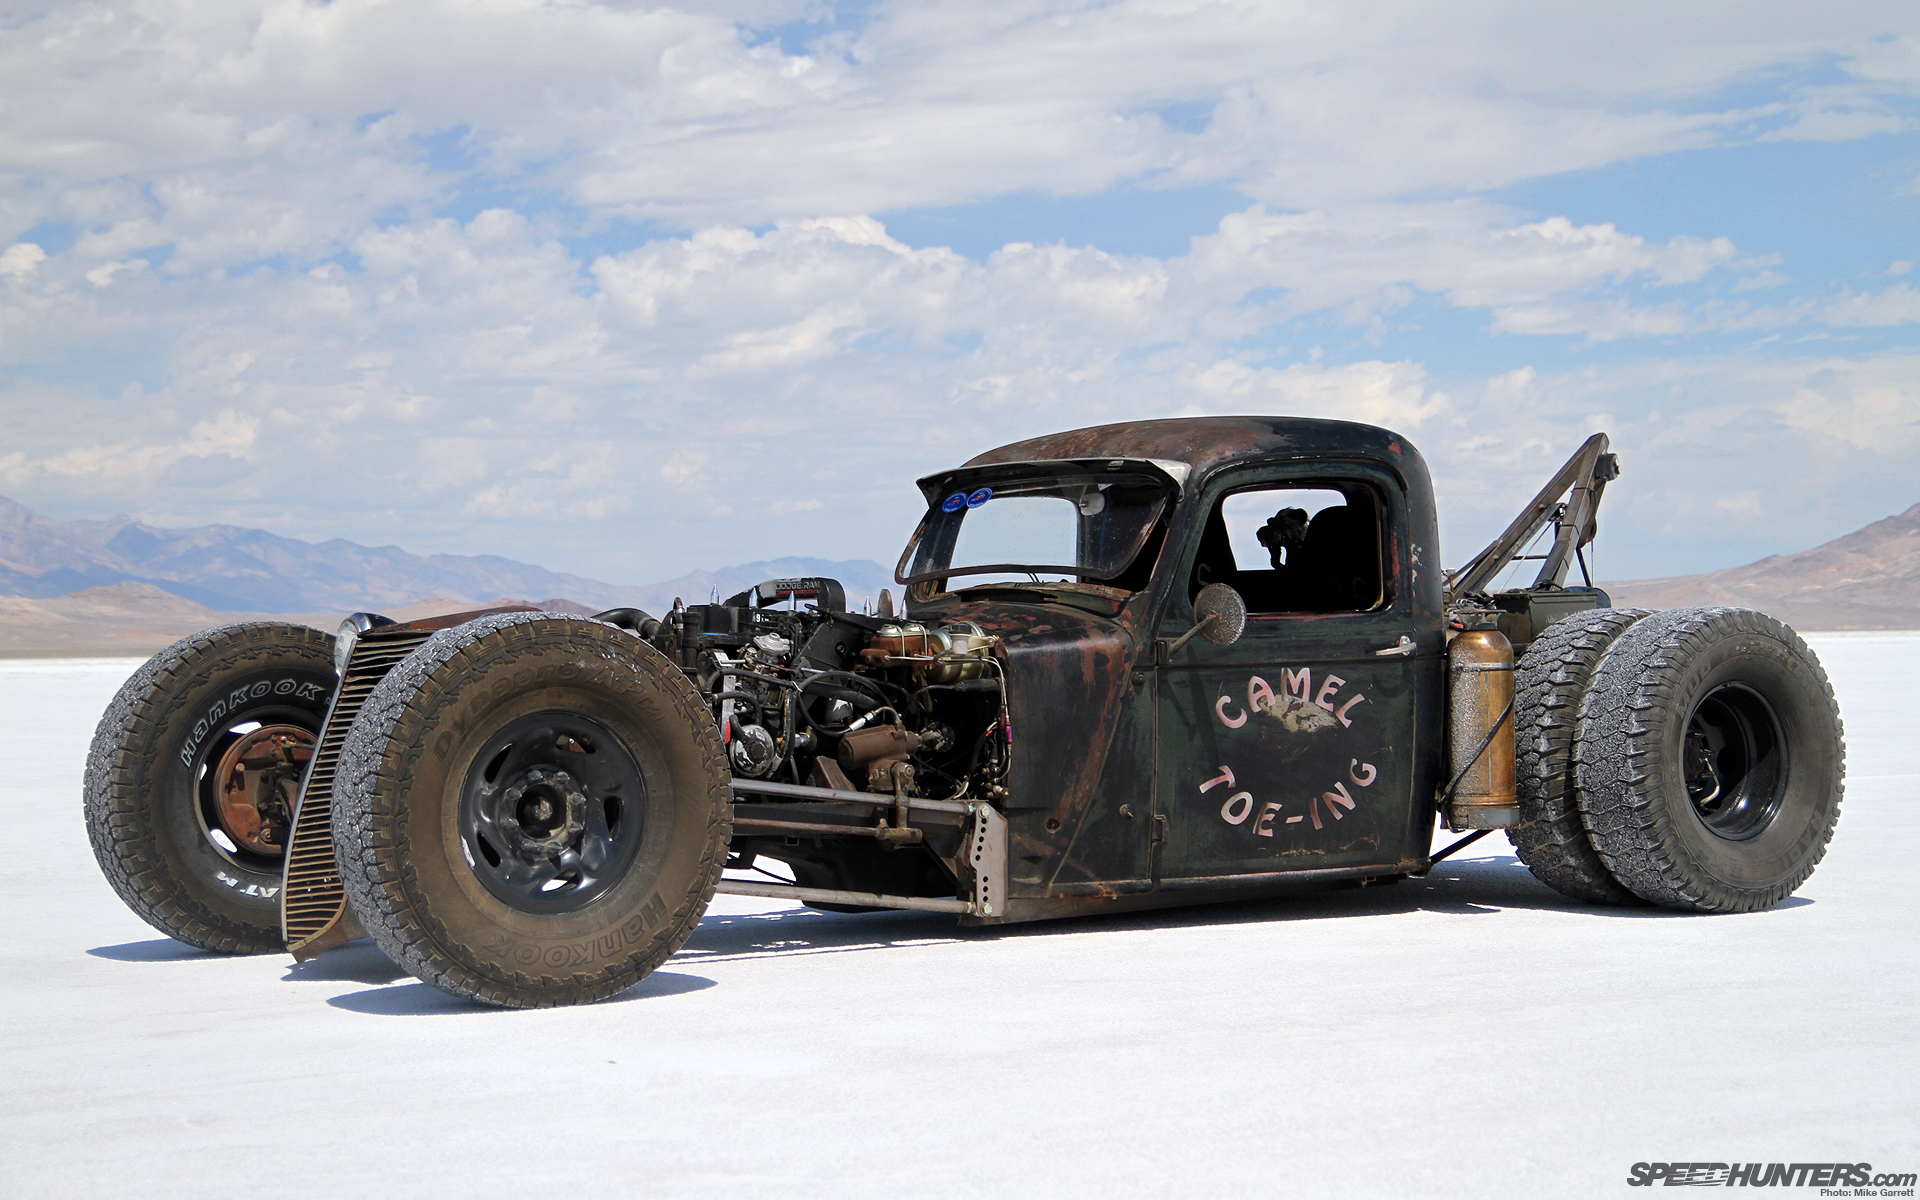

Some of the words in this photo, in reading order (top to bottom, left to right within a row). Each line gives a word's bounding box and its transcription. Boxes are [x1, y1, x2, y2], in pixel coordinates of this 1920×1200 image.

[775, 582, 803, 590] DODGE
[803, 580, 821, 589] RAM
[1215, 667, 1365, 728] CAMEL
[1199, 758, 1377, 837] TOE-ING
